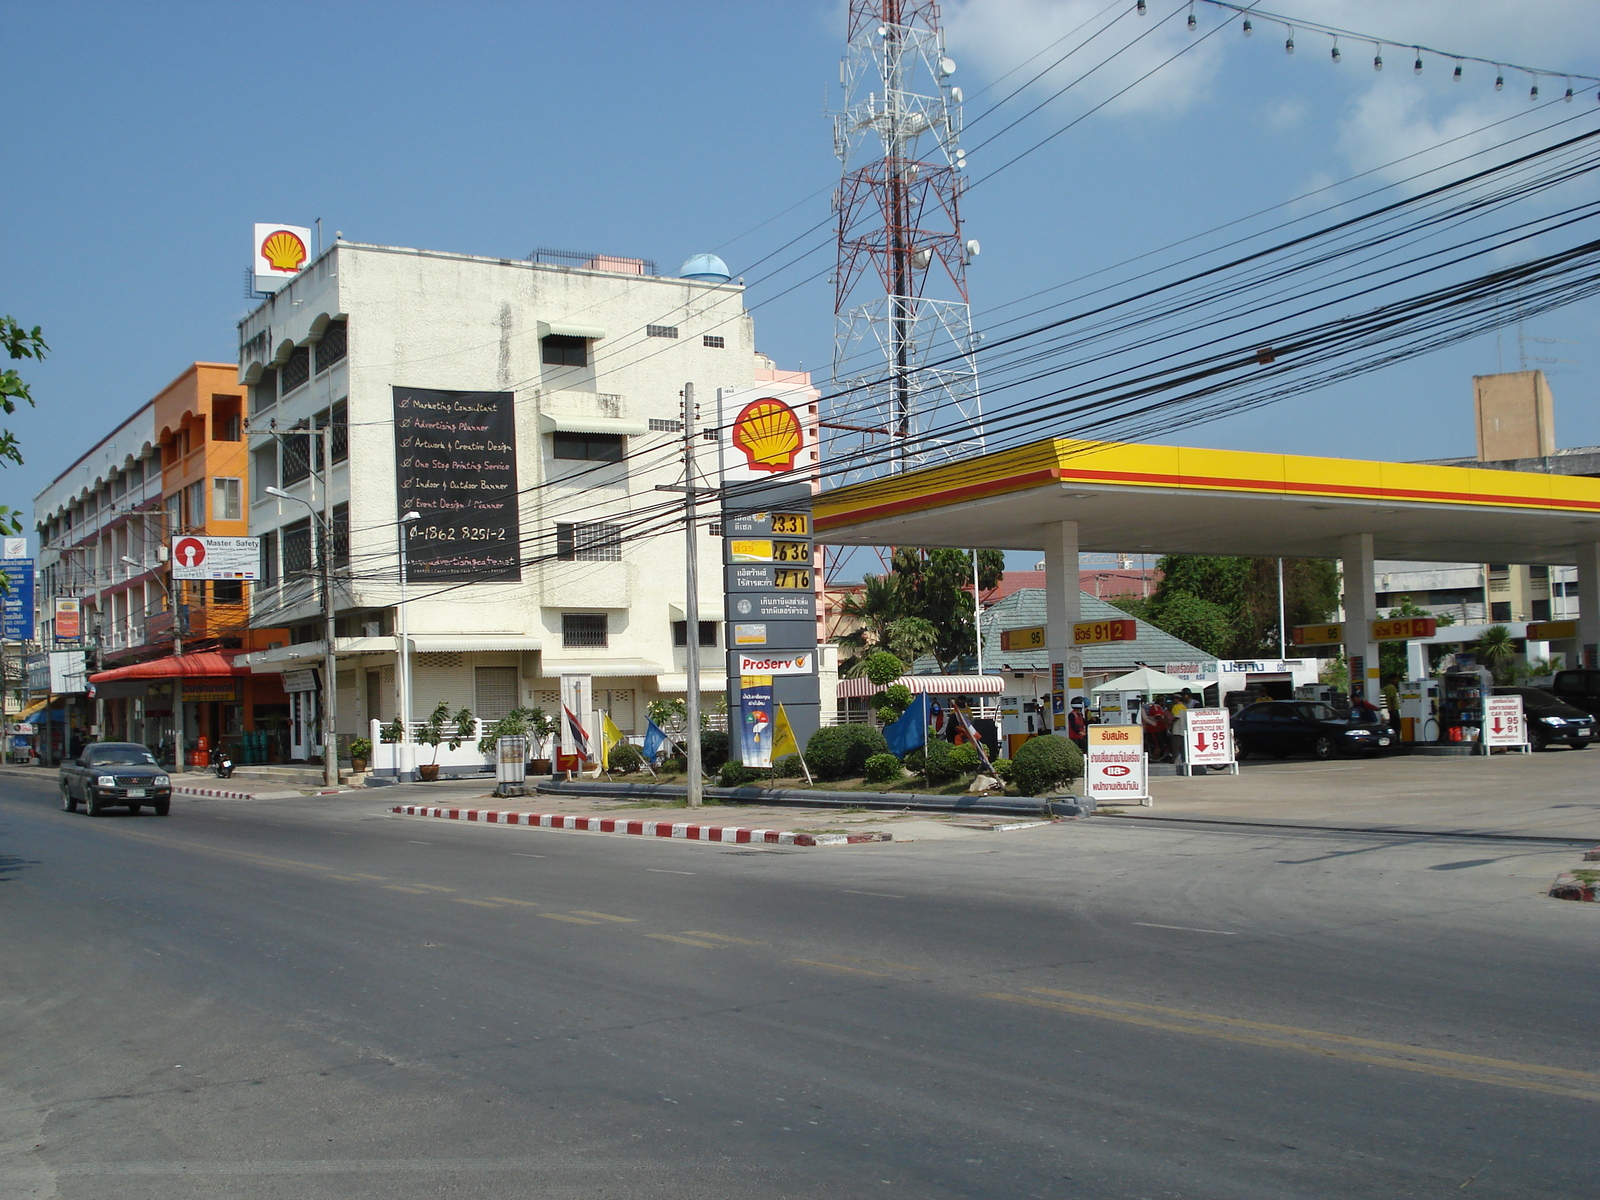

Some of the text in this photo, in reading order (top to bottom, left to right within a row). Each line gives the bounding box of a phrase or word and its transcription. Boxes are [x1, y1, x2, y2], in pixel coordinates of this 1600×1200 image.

[413, 400, 498, 413] Marketing Consultant
[414, 418, 489, 433] Advertising Planner
[414, 438, 445, 449] Artwork
[454, 440, 485, 451] Creative
[487, 441, 513, 453] Design
[414, 460, 510, 472] One Stop Printing Service
[415, 478, 440, 489] Indoor
[450, 480, 478, 490] Outdoor
[480, 480, 508, 490] Banner
[416, 498, 437, 508] Event
[440, 498, 465, 511] Design
[771, 515, 805, 533] 23.31
[461, 526, 506, 540] 8251-2
[1075, 623, 1123, 641] ชัวร์ 91 2
[1327, 628, 1337, 639] 95
[1393, 622, 1410, 635] 91
[1416, 623, 1424, 634] 4
[1031, 632, 1041, 644] 95
[742, 659, 793, 670] ProServ
[1069, 661, 1080, 673] 91
[1101, 730, 1129, 740] รับสมัคร
[1212, 732, 1225, 740] 95
[1212, 742, 1225, 750] 91
[1107, 767, 1126, 775] และ
